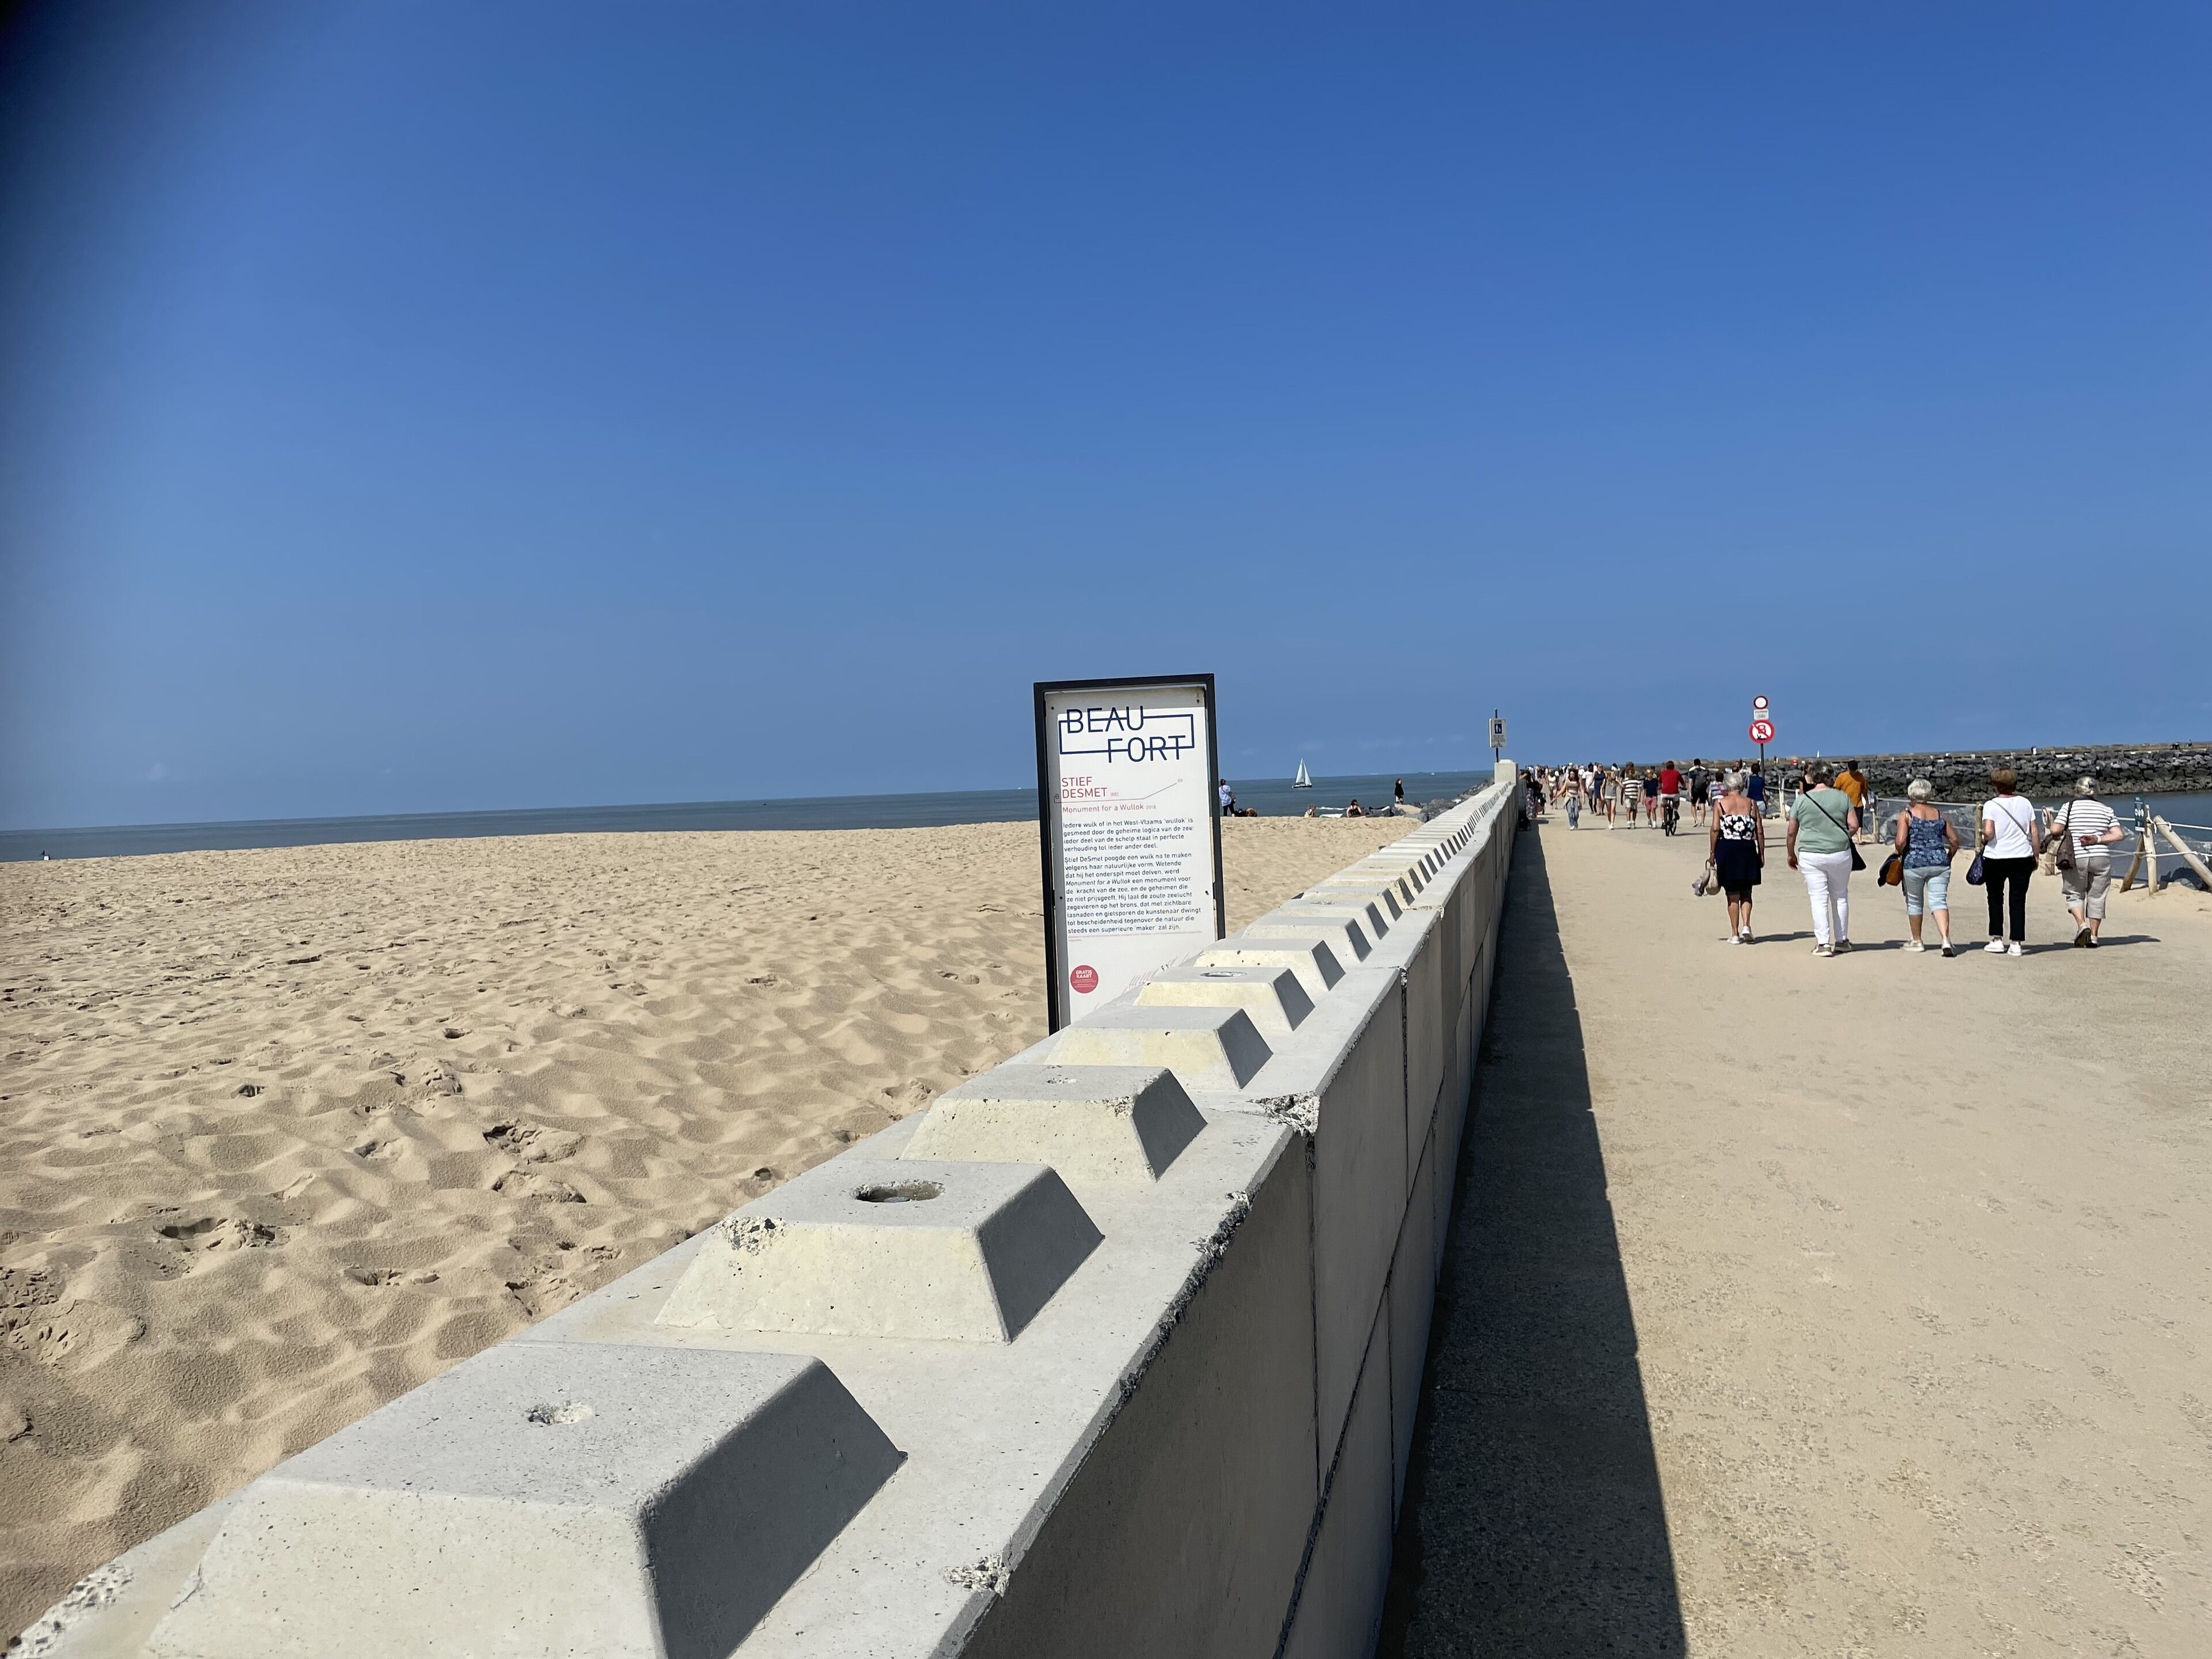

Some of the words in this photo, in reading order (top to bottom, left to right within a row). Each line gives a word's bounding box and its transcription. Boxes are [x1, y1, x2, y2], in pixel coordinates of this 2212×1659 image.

[1066, 705, 1144, 733] BEAU
[1108, 735, 1186, 763] FORT
[1062, 777, 1092, 787] STIEF
[1063, 787, 1107, 798] DESMET
[1063, 805, 1100, 813] Monument
[1063, 830, 1090, 838] gesmeed
[1077, 918, 1123, 926] bescheidenheid
